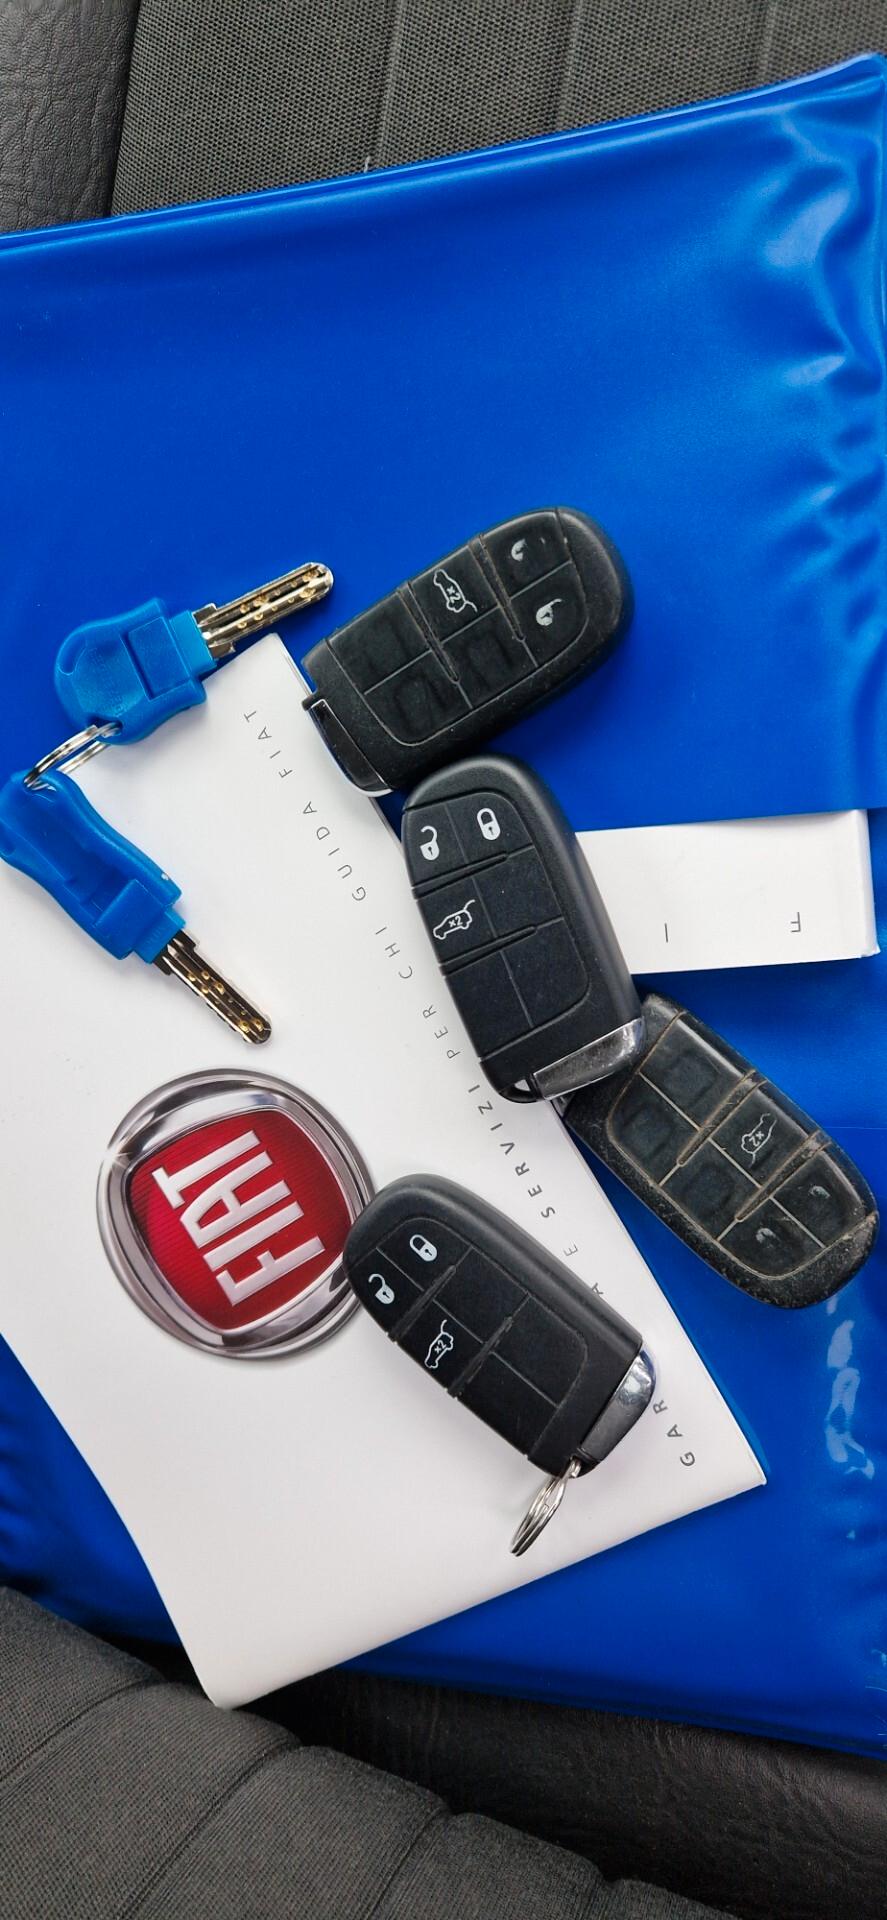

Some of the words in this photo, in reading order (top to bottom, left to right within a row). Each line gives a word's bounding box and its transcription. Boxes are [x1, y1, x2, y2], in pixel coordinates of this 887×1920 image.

[243, 710, 293, 779] FIAT
[302, 801, 367, 901] GUIDA
[375, 926, 413, 979] CHI
[422, 1004, 462, 1059] PER
[467, 1084, 556, 1219] SERVIZI
[152, 1129, 326, 1307] FIAT
[563, 1243, 579, 1257] E
